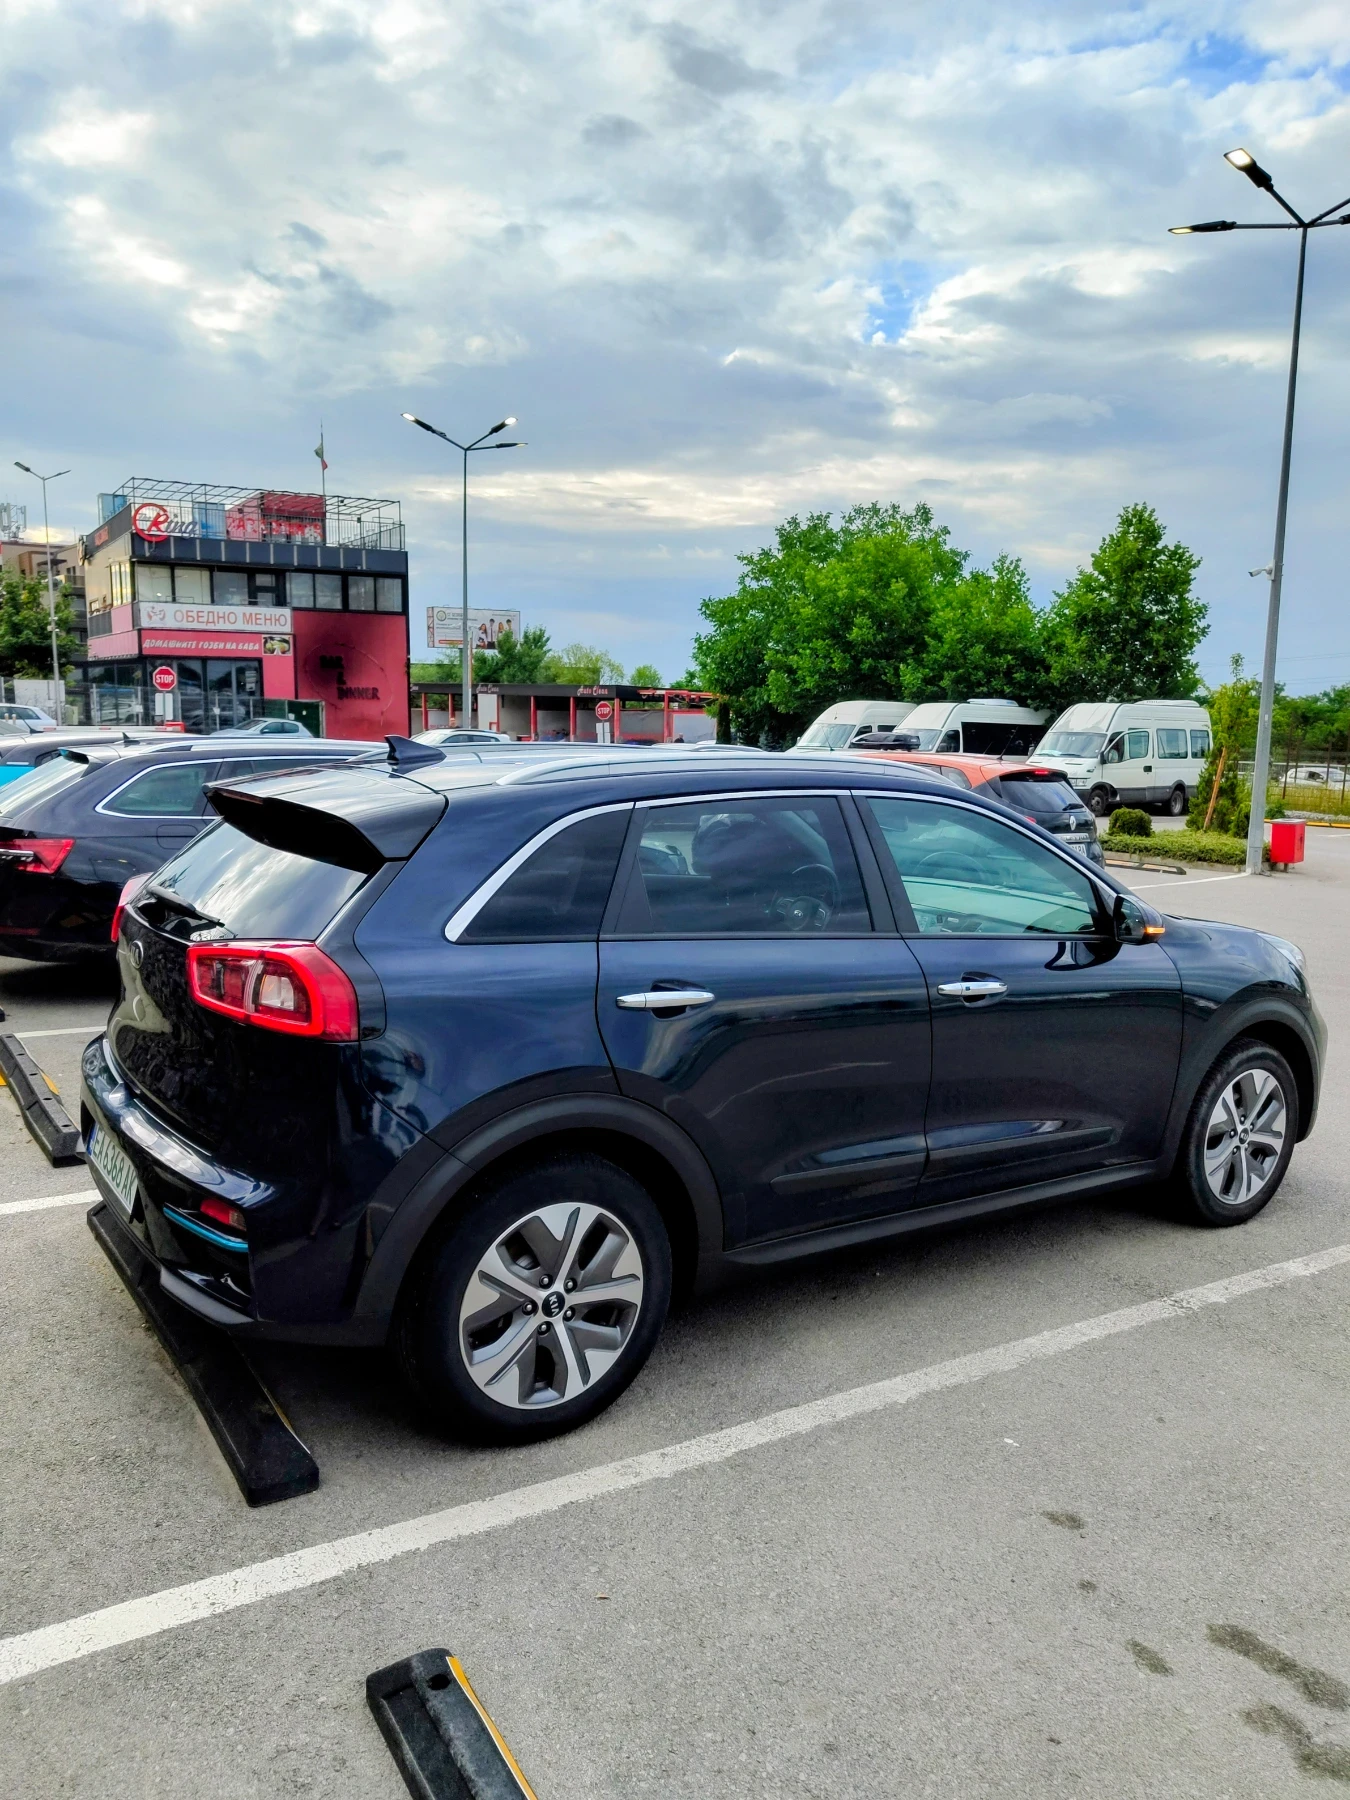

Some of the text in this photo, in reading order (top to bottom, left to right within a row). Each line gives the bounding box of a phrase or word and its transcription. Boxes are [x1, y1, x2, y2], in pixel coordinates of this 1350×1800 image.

[145, 511, 198, 539] Ring
[173, 609, 288, 627] ОБЕДНО МЕНЮ
[142, 638, 197, 649] ДОМАШНИТЕ
[225, 641, 236, 650] НА
[238, 642, 260, 651] БАБА
[155, 674, 174, 683] STOP
[337, 687, 380, 700] DINNER
[577, 685, 608, 696] Auto Clean
[597, 707, 610, 715] STOP
[549, 1294, 560, 1316] KIA
